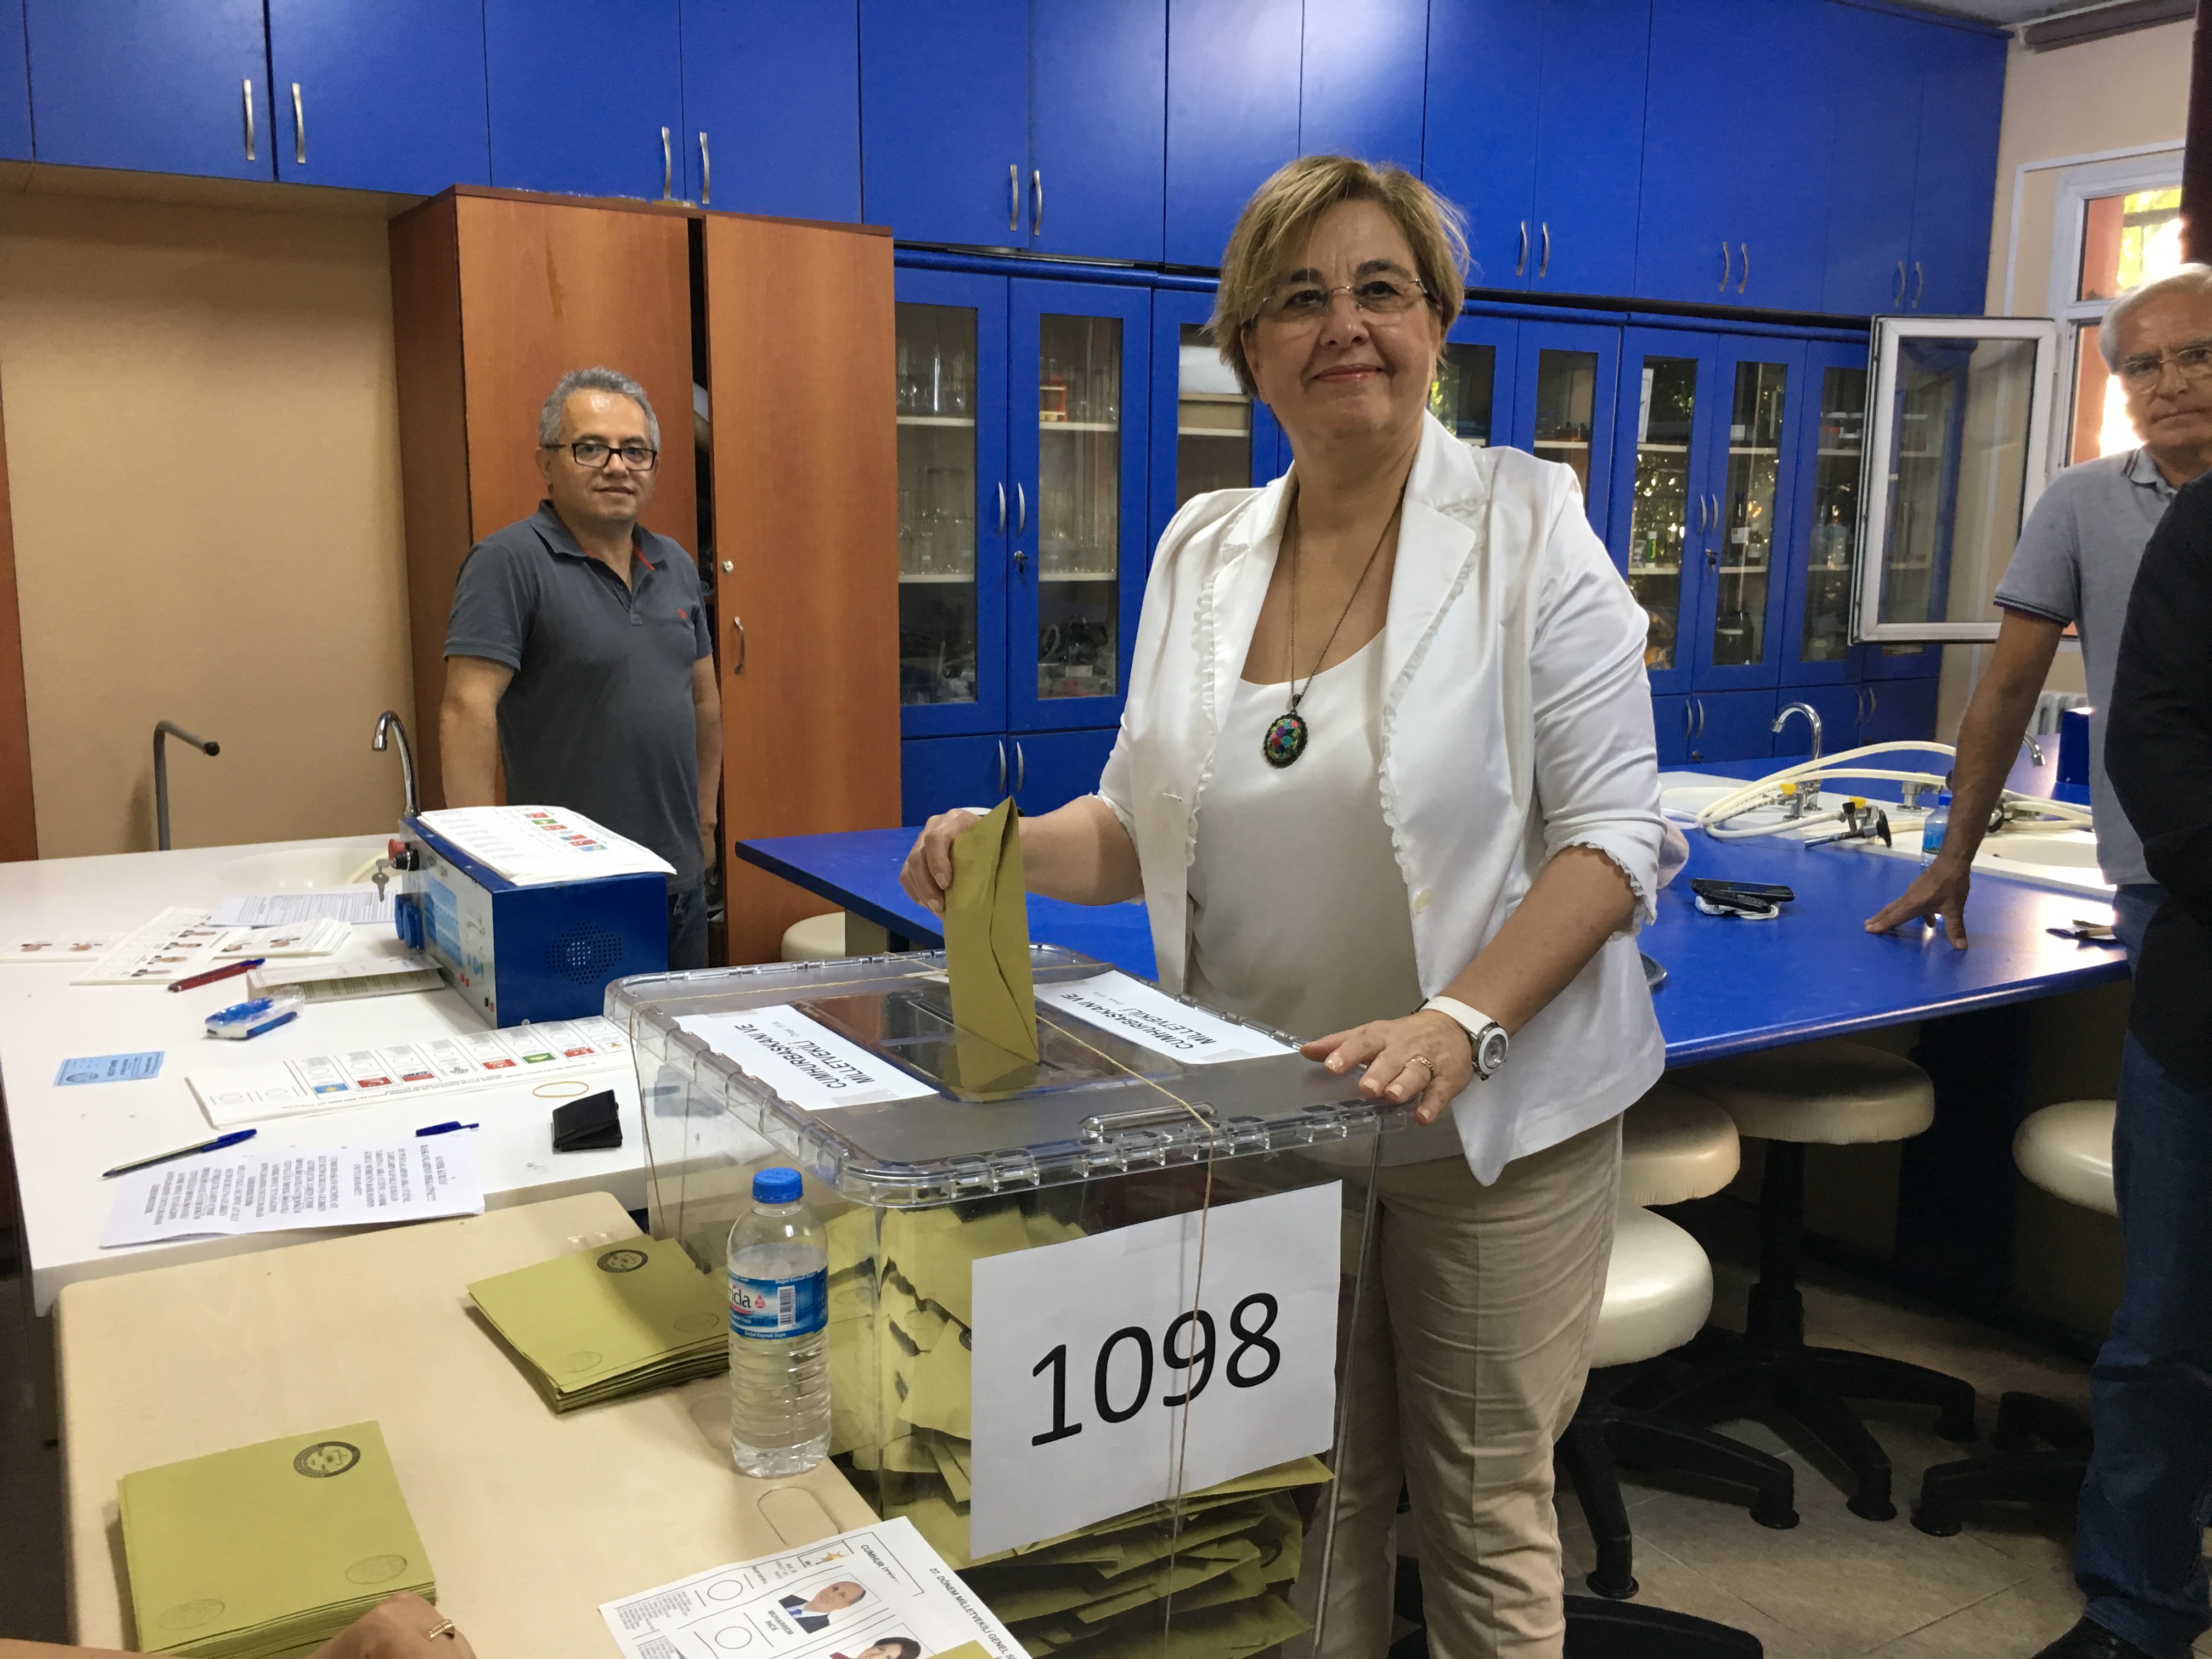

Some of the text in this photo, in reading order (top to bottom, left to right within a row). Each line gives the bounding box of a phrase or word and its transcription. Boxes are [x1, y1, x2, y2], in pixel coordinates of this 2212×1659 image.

[1077, 1001, 1194, 1049] CUMHURBAŞKANI
[1118, 1008, 1217, 1045] MİLLETVEKİLİ
[734, 1023, 847, 1088] CUMHURBAŞKANI VE
[788, 1040, 876, 1084] MİLLETVEKİLİ
[1031, 1293, 1281, 1447] 1098
[860, 1544, 884, 1567] CUMHUR
[768, 1609, 794, 1635] MUHARREM
[936, 1576, 960, 1597] DÖNEM
[955, 1595, 994, 1634] MİLLETVEKİLİ
[988, 1633, 1009, 1654] GENEL
